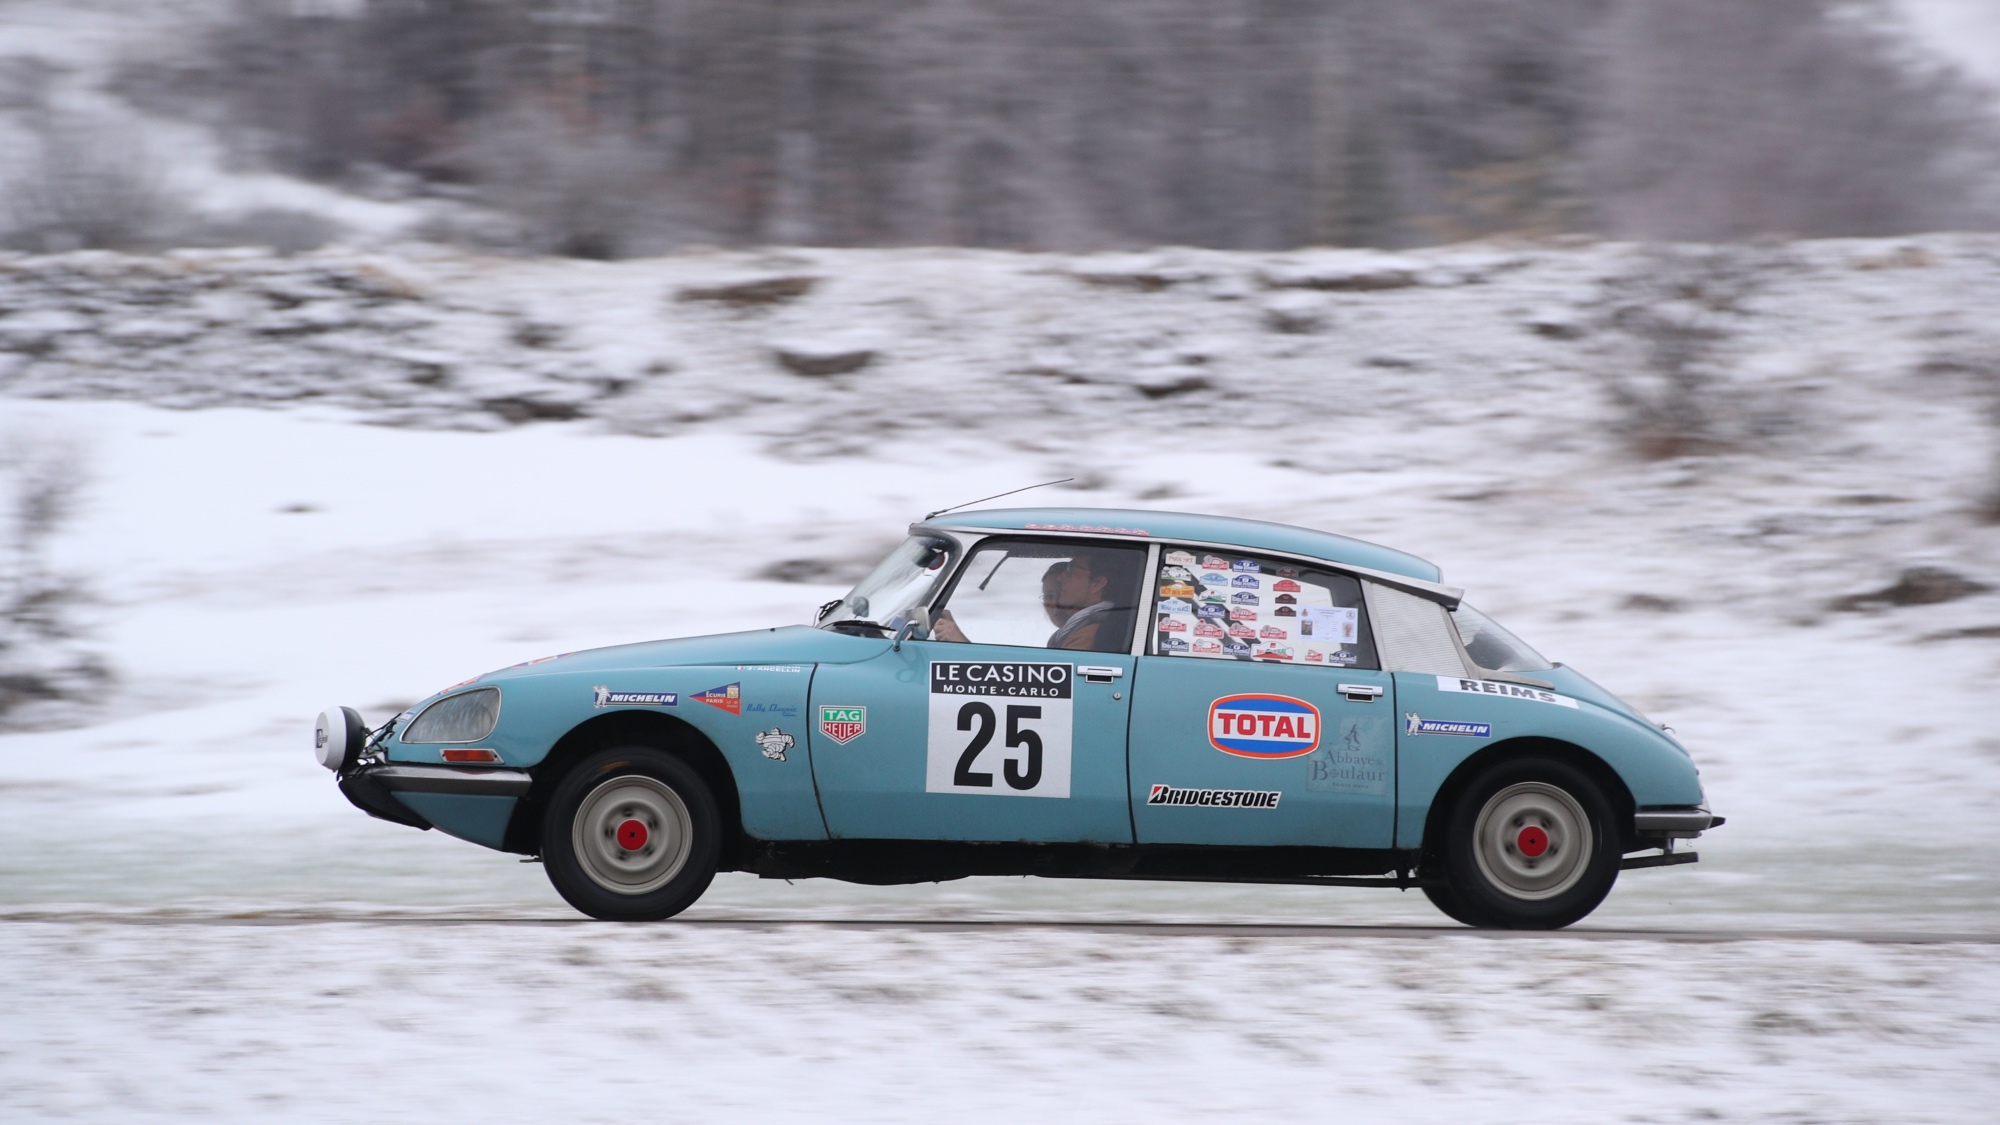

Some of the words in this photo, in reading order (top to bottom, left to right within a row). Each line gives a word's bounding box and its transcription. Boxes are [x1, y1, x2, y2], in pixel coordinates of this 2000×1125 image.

[936, 664, 960, 681] LE
[966, 664, 1067, 684] CASINO
[610, 693, 676, 704] MICHELIN
[1459, 679, 1557, 703] REIMS
[746, 703, 766, 713] Rally
[825, 710, 860, 721] TAG
[824, 722, 861, 740] HEUER
[1218, 712, 1311, 739] TOTAL
[1422, 722, 1489, 734] MICHELIN
[953, 701, 1043, 791] 25
[1324, 750, 1375, 770] Abbaye
[1312, 760, 1385, 781] Boulaur
[1149, 785, 1280, 808] BRIDGESTONE
